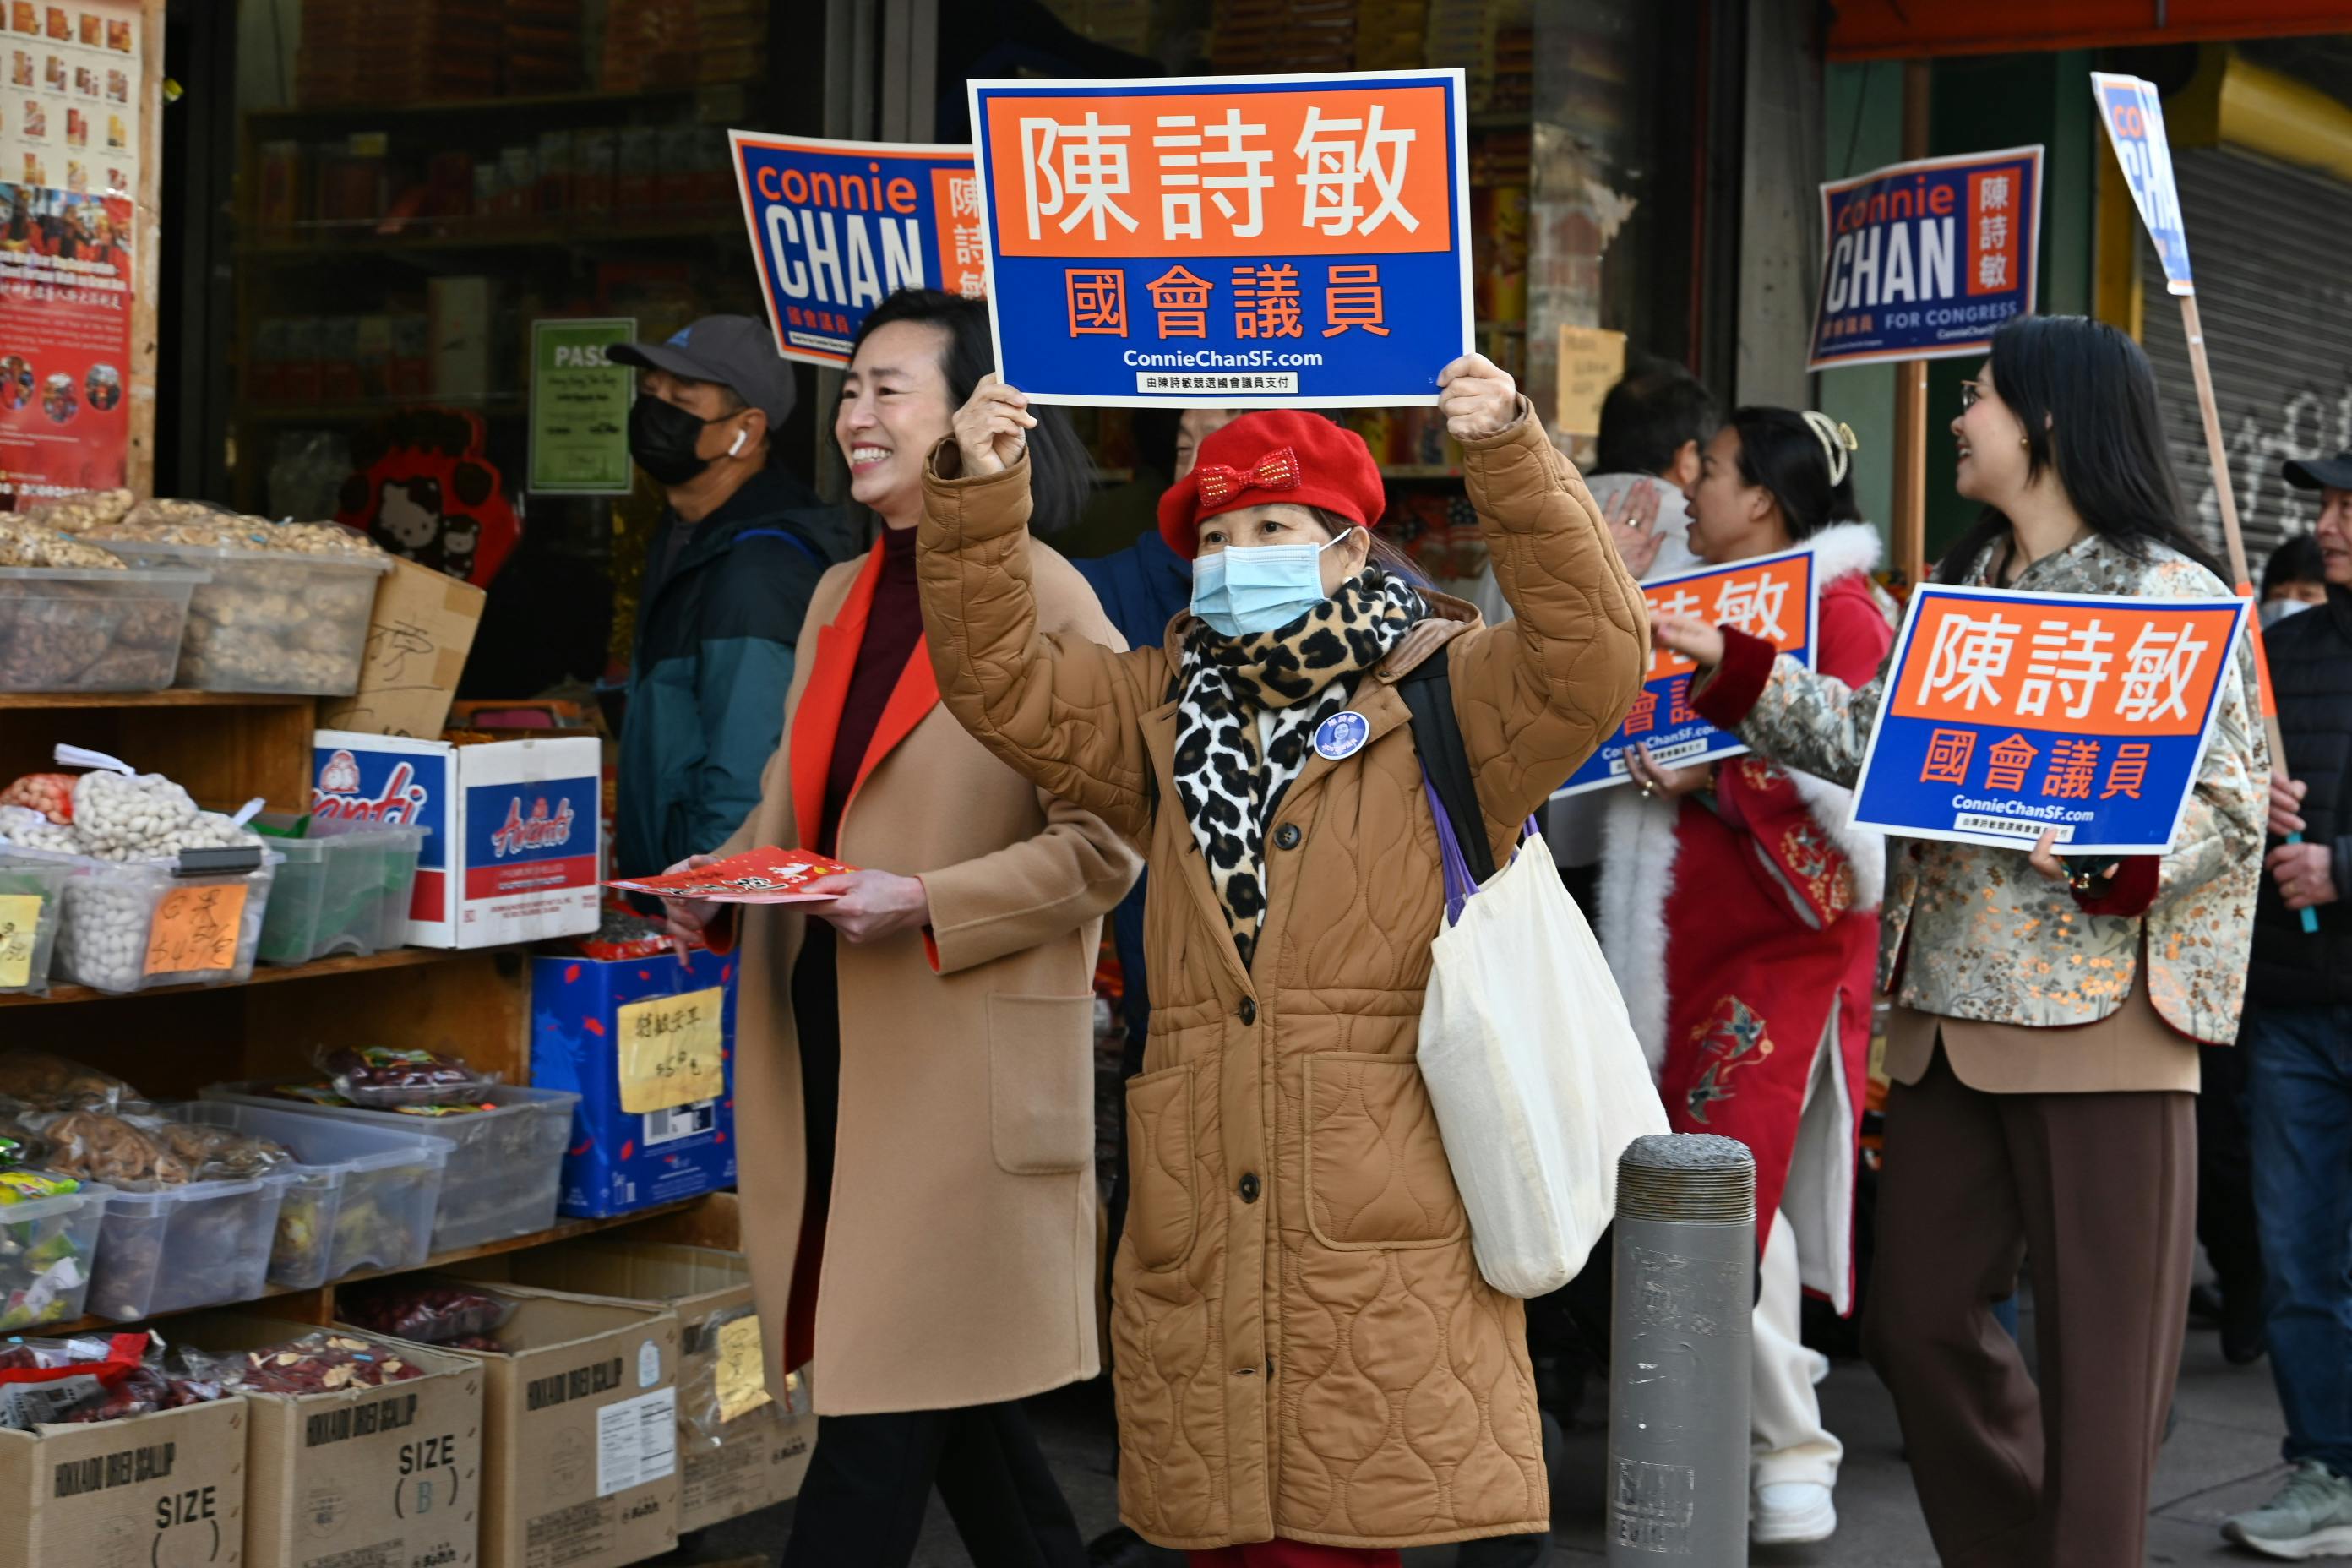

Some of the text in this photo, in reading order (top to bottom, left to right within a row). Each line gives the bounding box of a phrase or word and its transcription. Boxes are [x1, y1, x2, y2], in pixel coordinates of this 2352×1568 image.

[756, 162, 917, 214] connie
[1019, 105, 1420, 241] 陳詩敏
[1838, 175, 1955, 234] connie
[1979, 176, 2009, 288] 陳詩敏
[765, 204, 925, 308] CHAN
[1826, 216, 1955, 314] CHAN
[1064, 264, 1391, 339] 國會議員
[1885, 301, 2018, 330] FOR CONGRESS
[1124, 349, 1323, 367] ConnieChanSF.com
[1146, 376, 1289, 389] 由陳詩敏競選國會議員支付
[1915, 613, 2208, 722] 陳詩敏
[1919, 728, 2150, 801] 國會議員
[1952, 794, 2095, 822] ConnieChanSF.com
[399, 1435, 455, 1475] SIZE
[156, 1486, 215, 1529] SIZE
